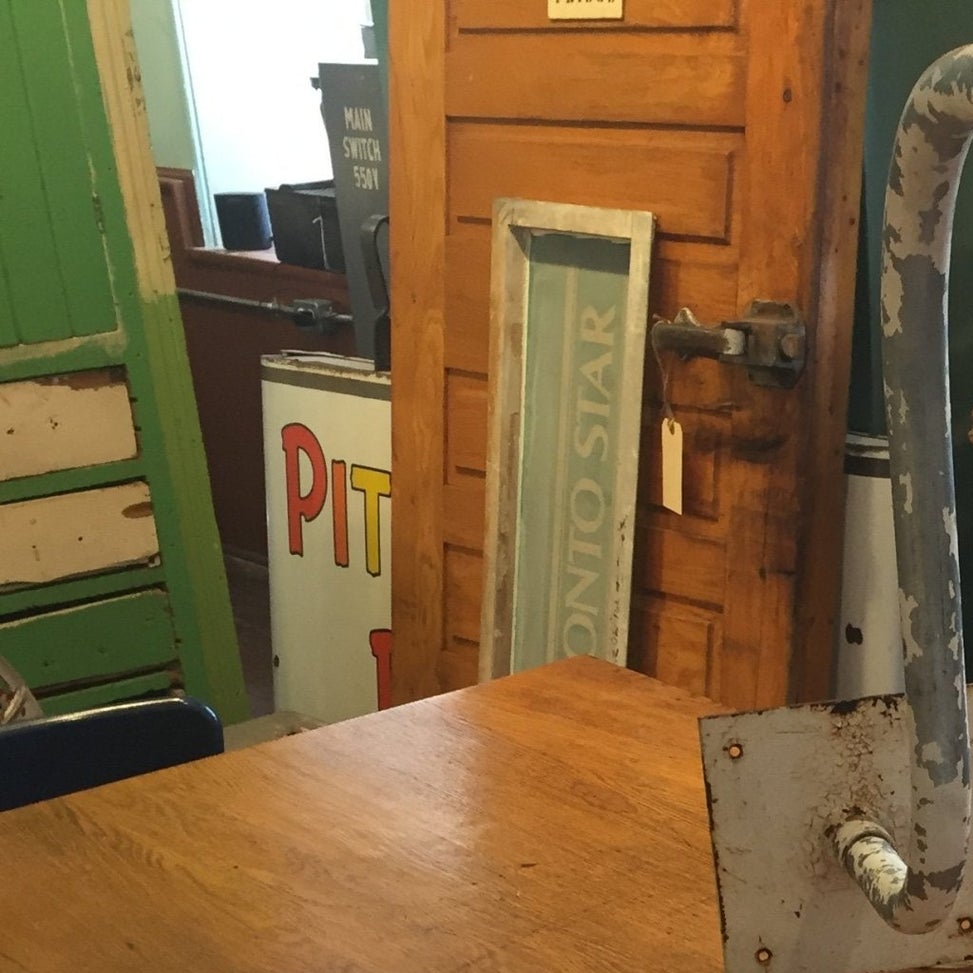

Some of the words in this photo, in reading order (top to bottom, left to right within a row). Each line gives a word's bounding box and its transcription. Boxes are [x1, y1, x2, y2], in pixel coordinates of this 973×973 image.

[344, 106, 373, 132] MAIN
[342, 136, 382, 162] SWITCH
[353, 165, 379, 190] 550V
[574, 303, 617, 462] STAR
